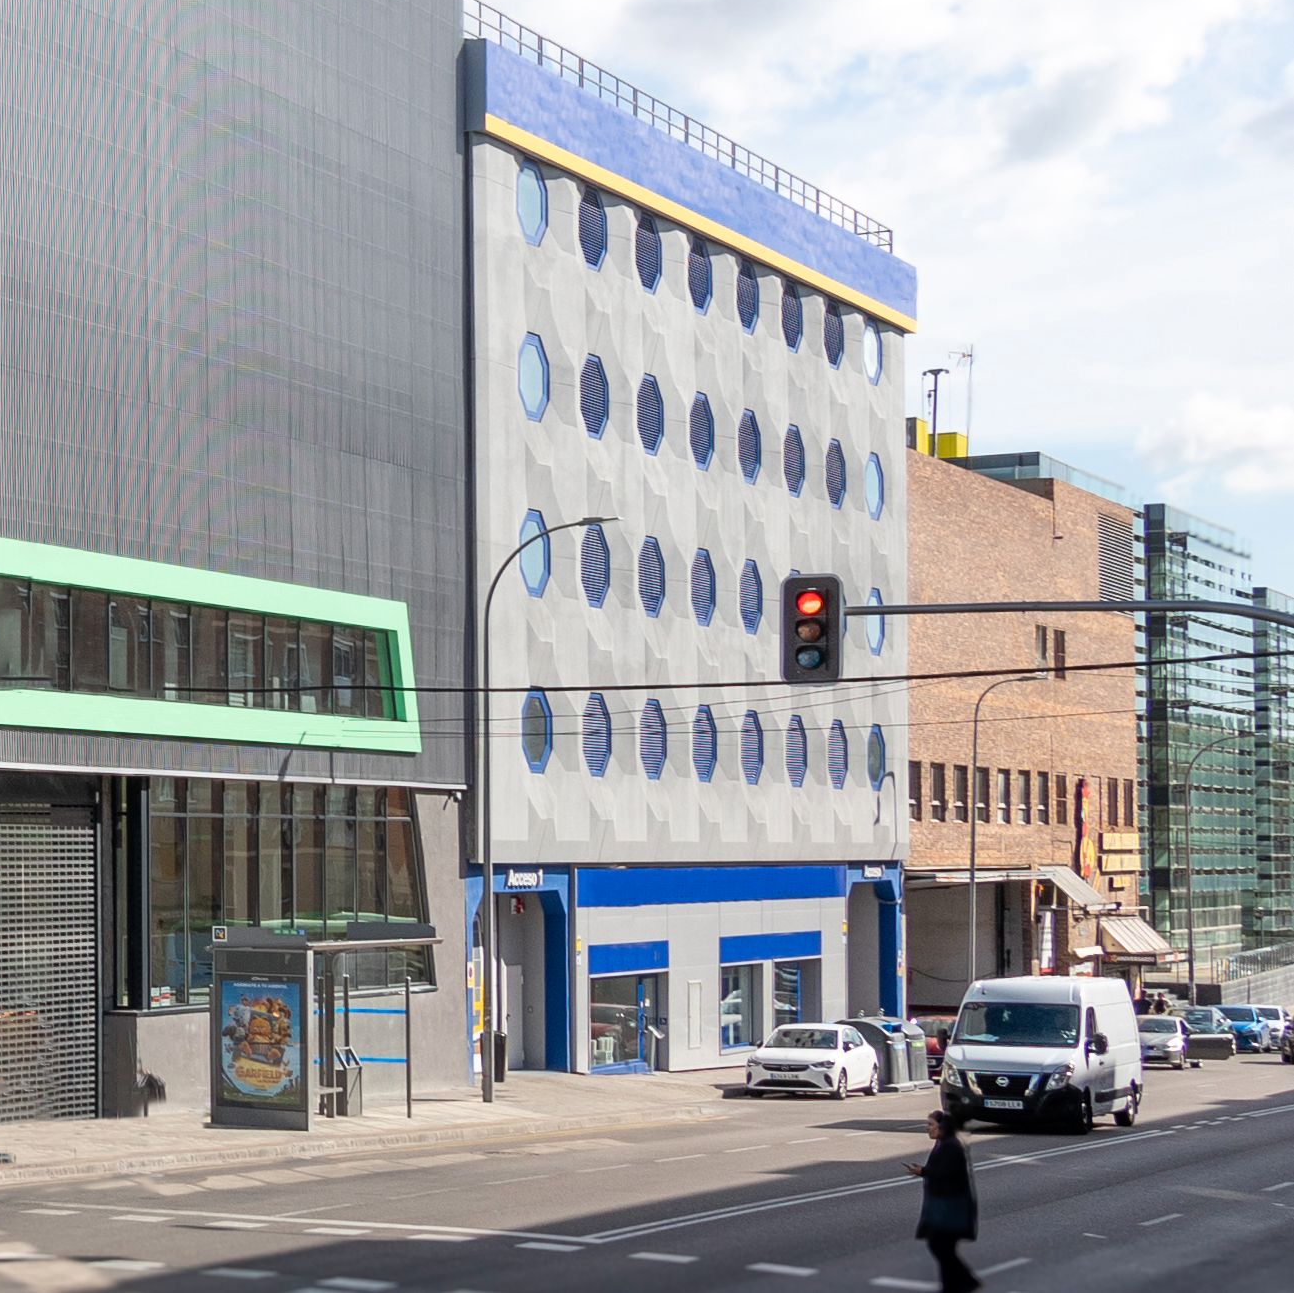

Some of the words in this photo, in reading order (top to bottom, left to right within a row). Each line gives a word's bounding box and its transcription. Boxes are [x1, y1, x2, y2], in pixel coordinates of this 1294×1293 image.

[507, 868, 538, 887] Acceso
[538, 868, 543, 886] 1
[235, 1066, 283, 1080] GARFIELD
